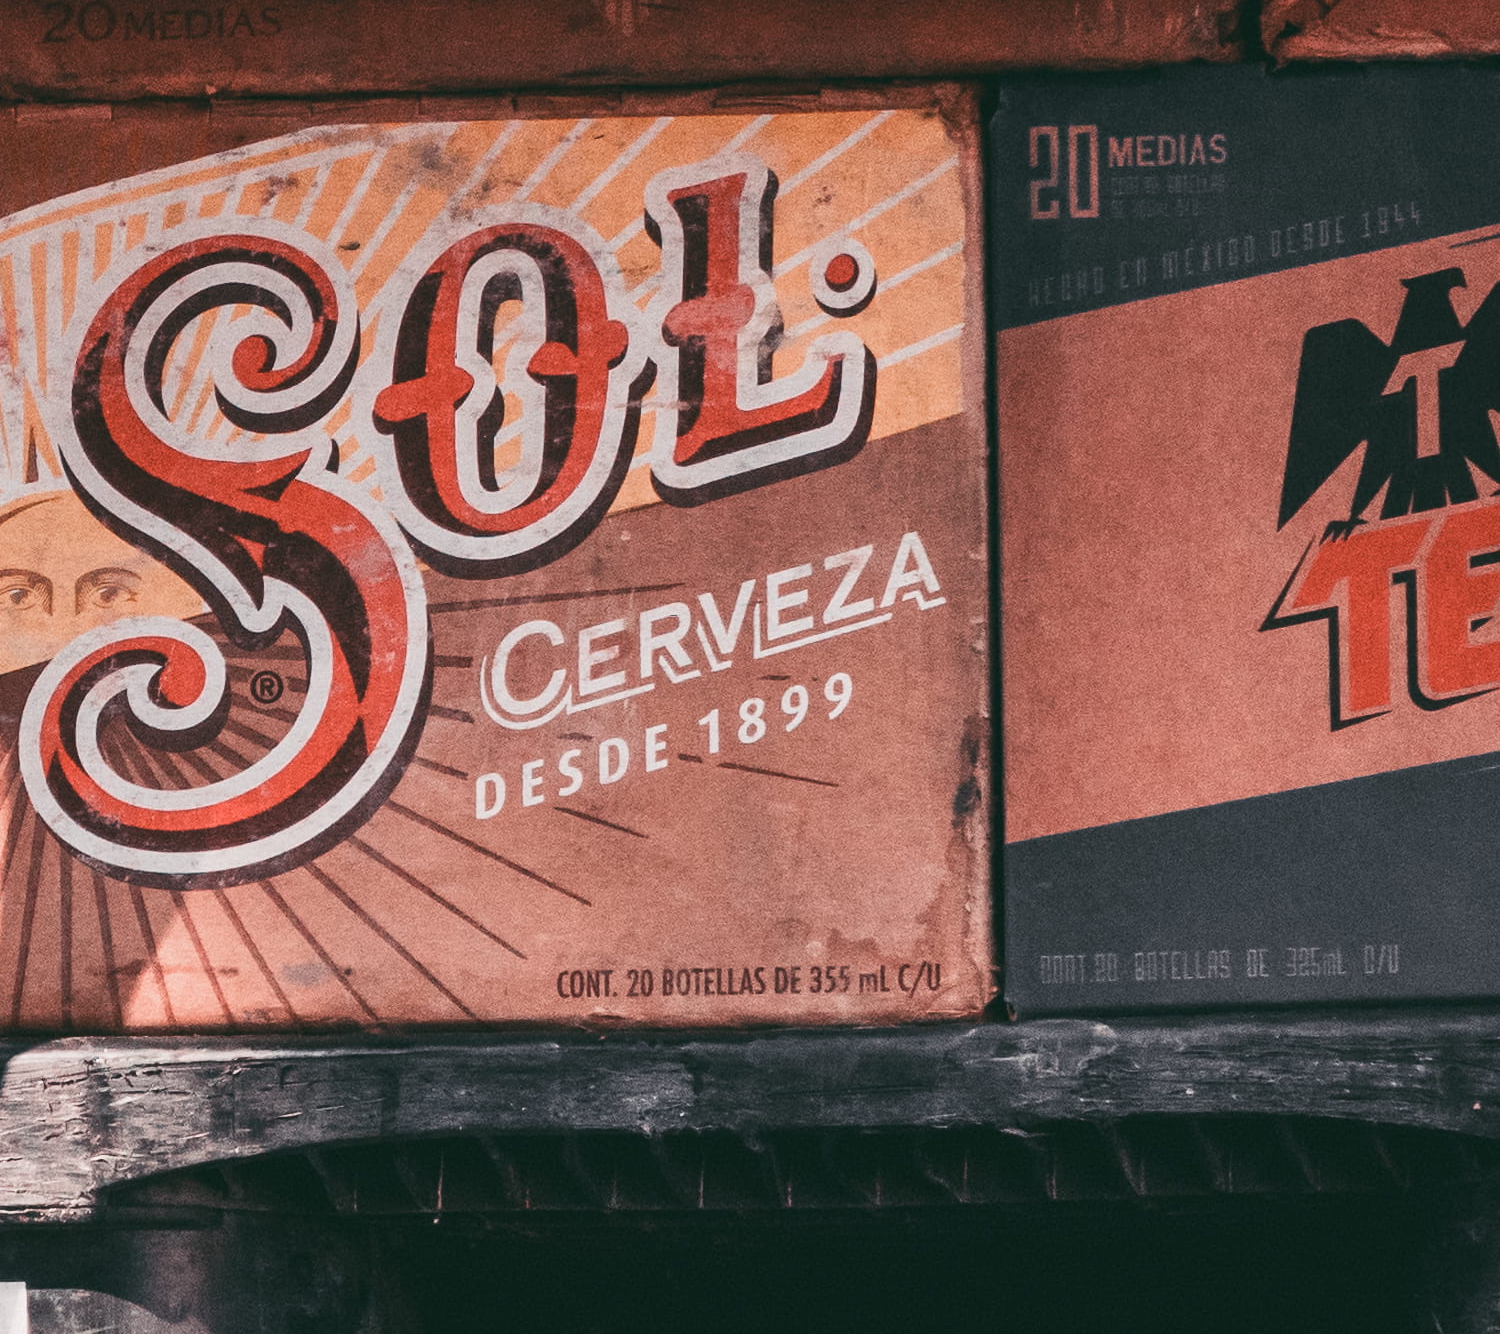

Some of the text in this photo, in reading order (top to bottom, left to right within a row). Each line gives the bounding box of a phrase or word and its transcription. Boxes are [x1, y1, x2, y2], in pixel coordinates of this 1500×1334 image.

[43, 0, 282, 44] 20 MEDIAS
[1027, 123, 1100, 222] 20
[1106, 133, 1229, 169] MEDIAS
[479, 530, 947, 731] CERVEZA
[474, 670, 854, 820] DESDE 1899
[555, 960, 943, 999] CONT. 20 BOTELLAS DE 355 mL C/U
[1132, 948, 1232, 983] BOTELLAS
[1246, 946, 1270, 978] DE
